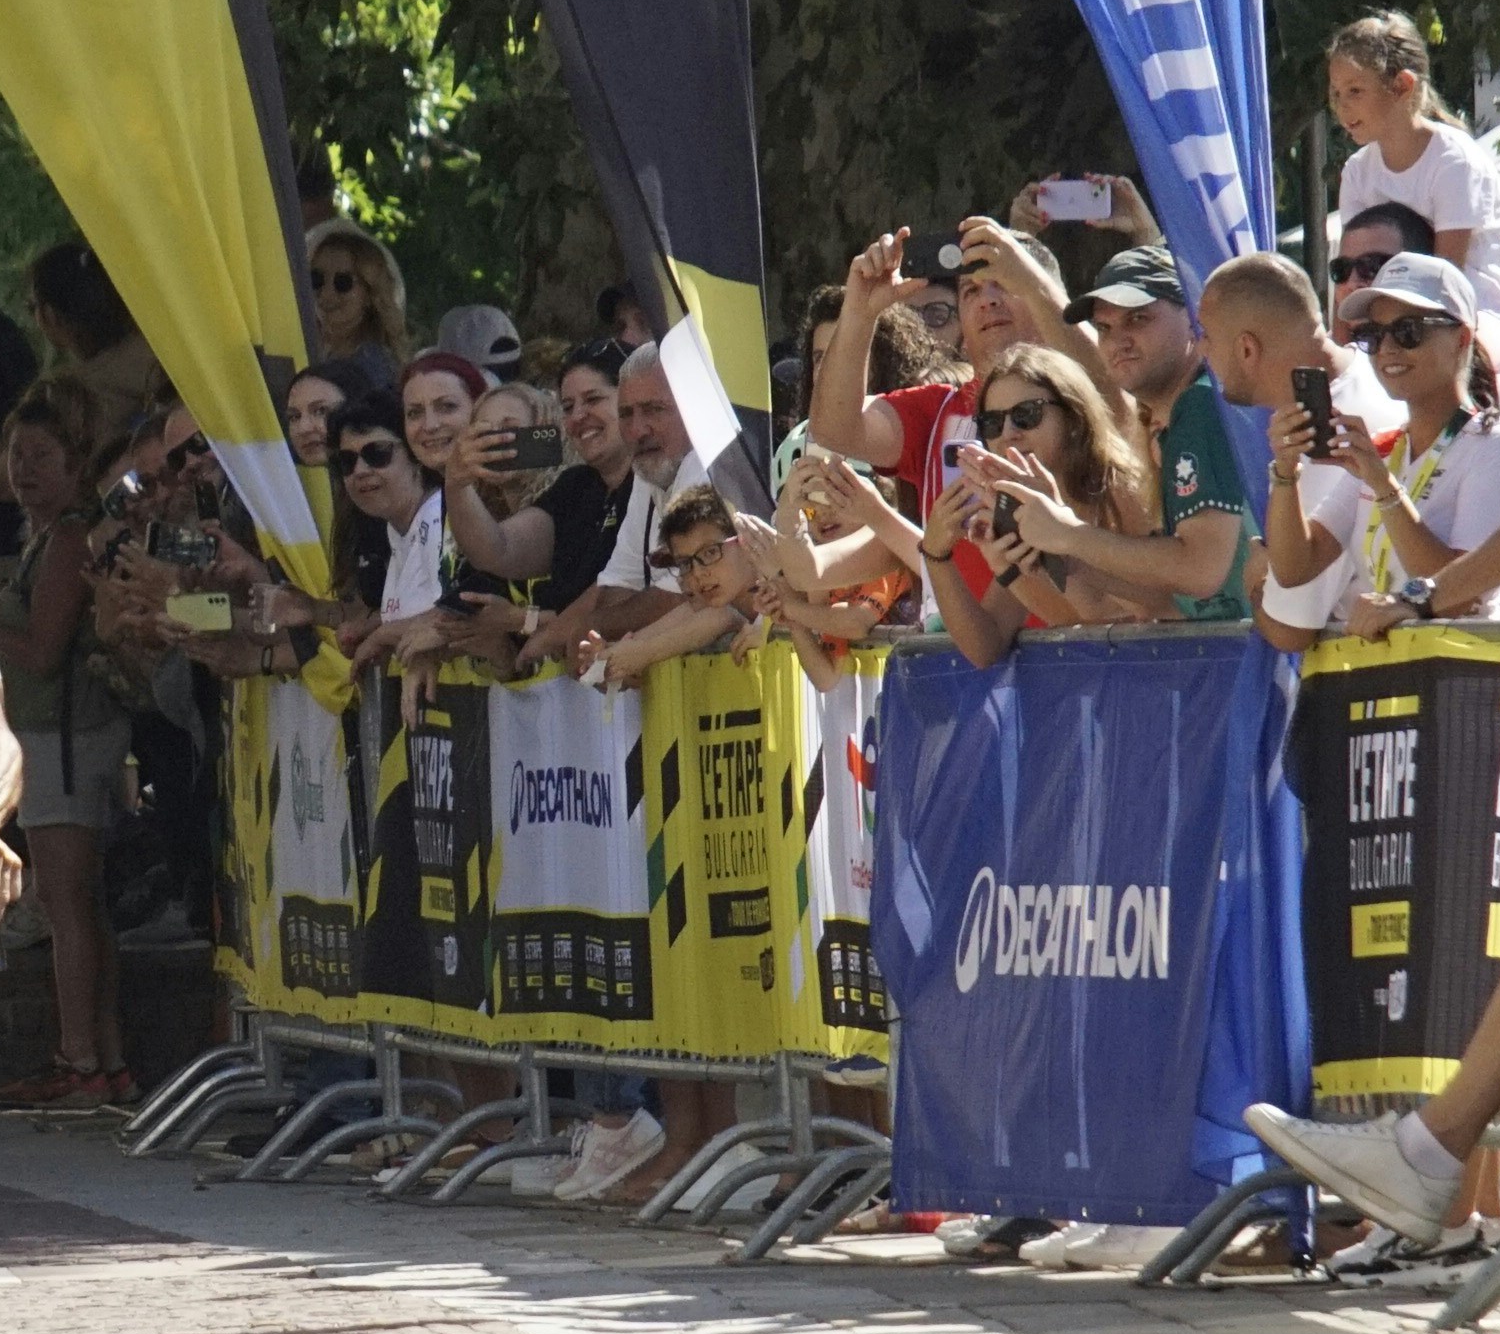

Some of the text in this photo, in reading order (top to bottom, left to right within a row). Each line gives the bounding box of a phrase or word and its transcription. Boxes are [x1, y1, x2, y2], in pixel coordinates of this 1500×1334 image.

[526, 765, 613, 829] DECATHLON
[703, 826, 769, 881] BULGARIA
[995, 883, 1172, 979] DECATHLON
